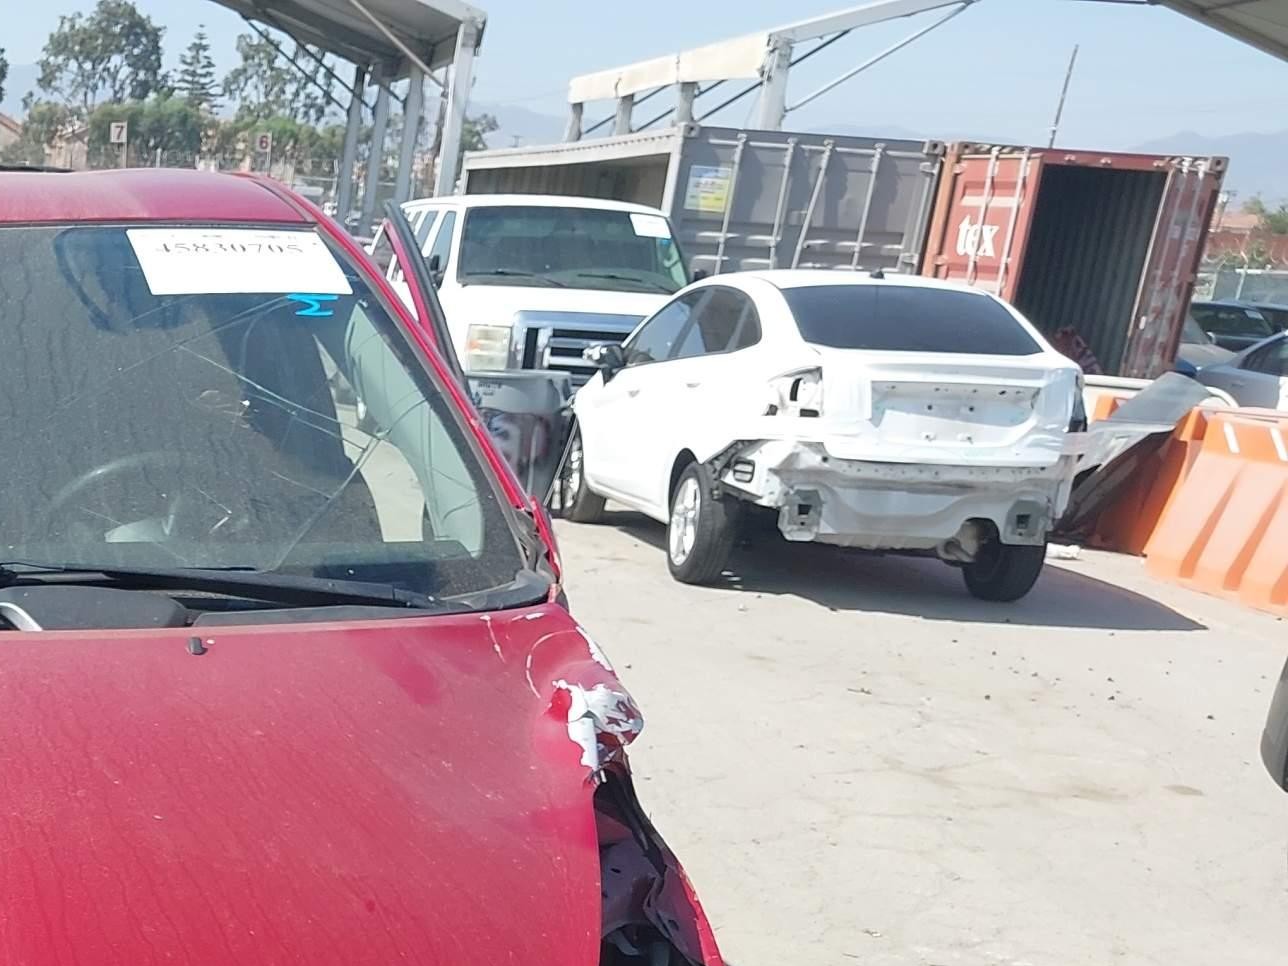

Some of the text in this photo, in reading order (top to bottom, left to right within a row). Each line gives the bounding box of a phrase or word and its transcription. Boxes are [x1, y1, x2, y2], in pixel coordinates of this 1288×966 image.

[115, 125, 125, 141] 7
[258, 134, 270, 149] 6
[956, 214, 1000, 258] tex
